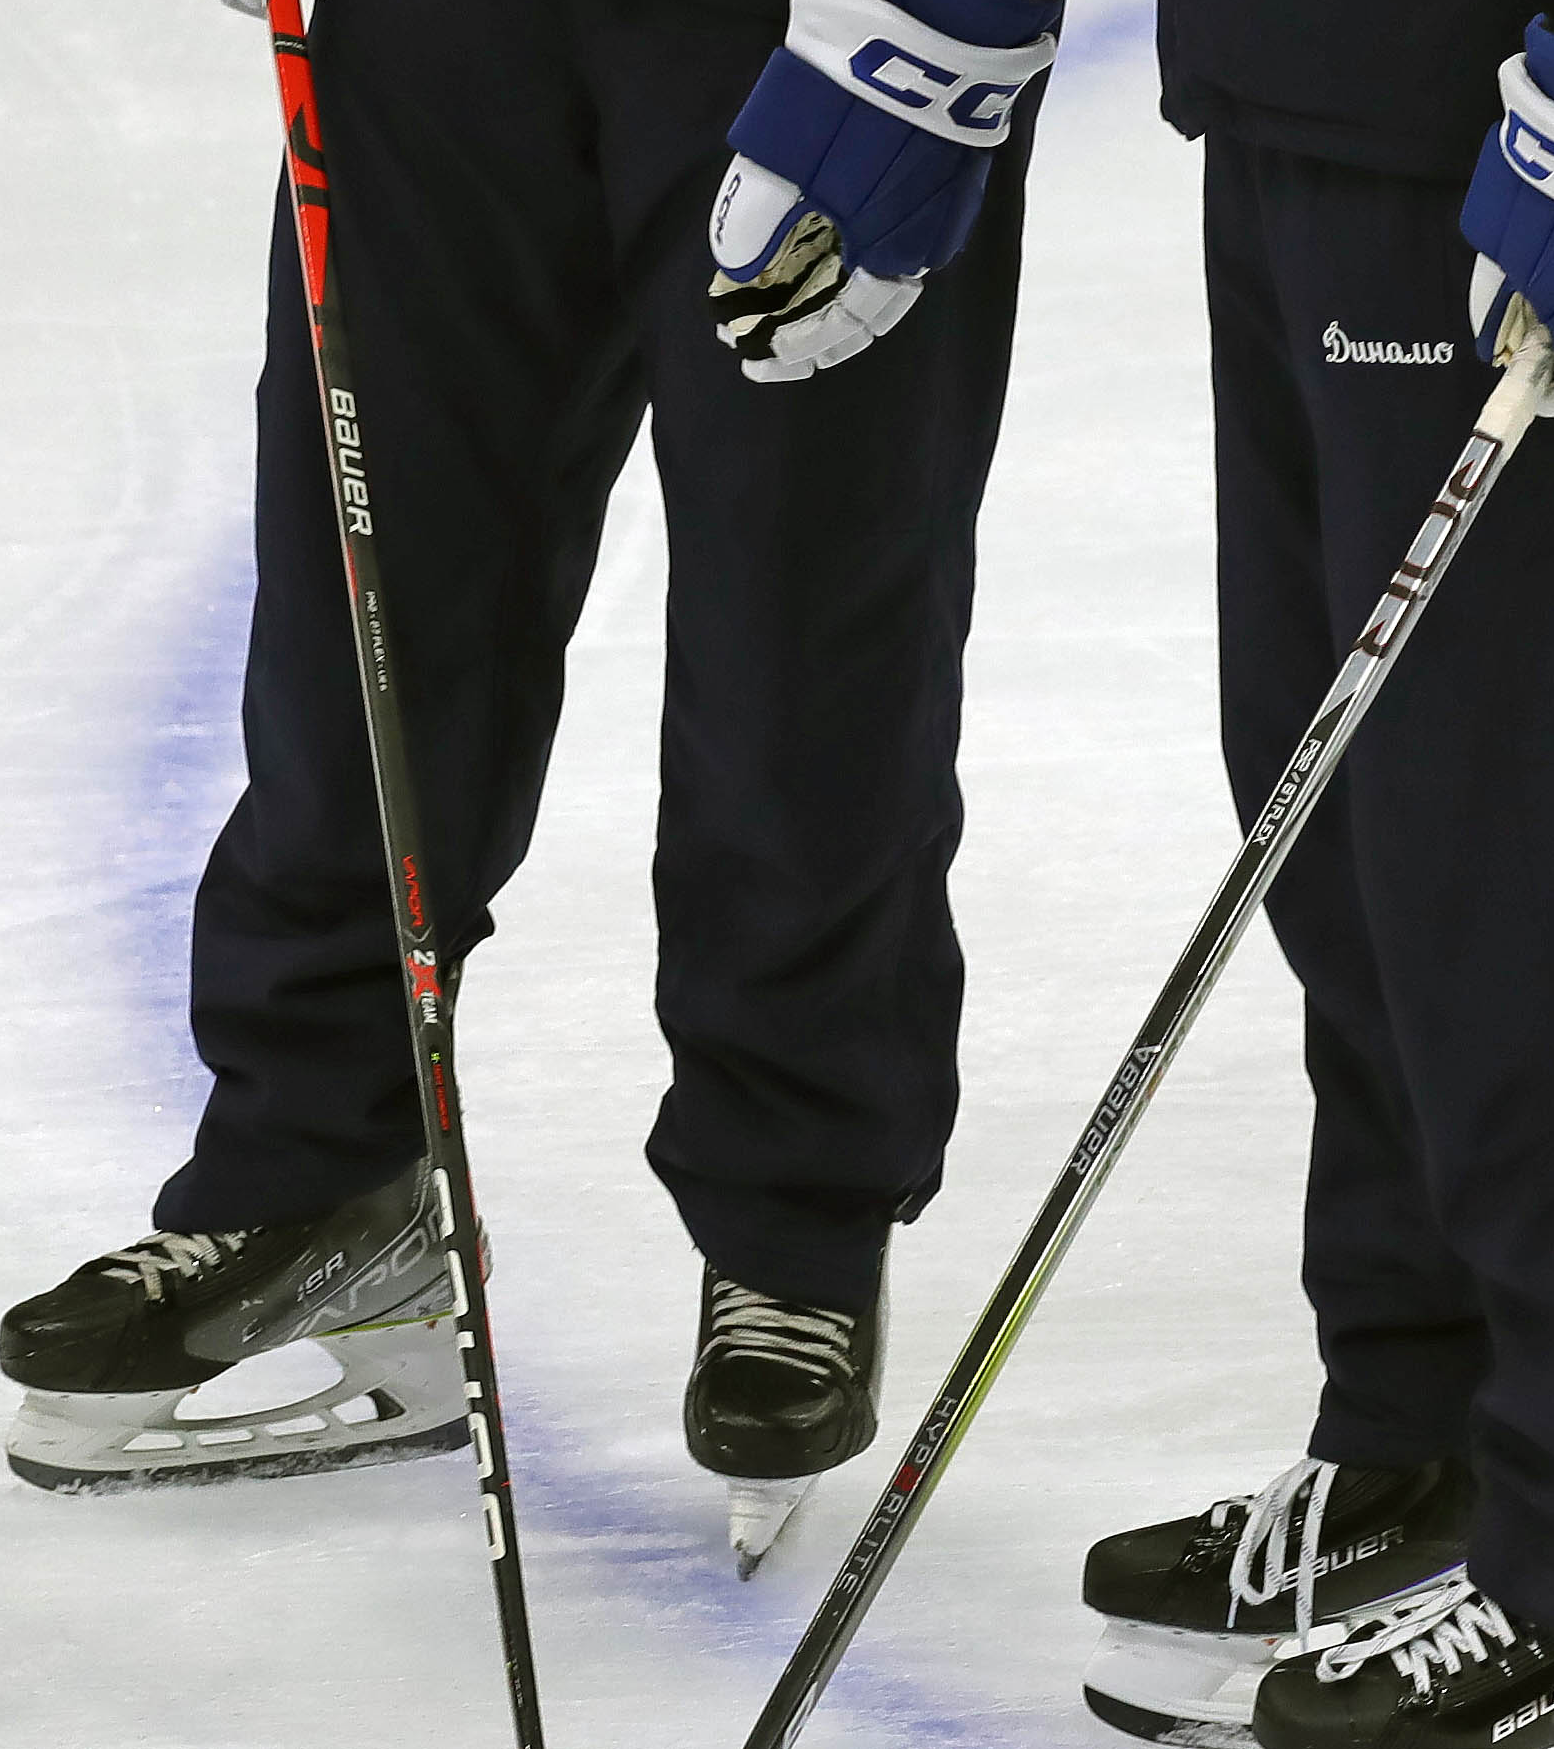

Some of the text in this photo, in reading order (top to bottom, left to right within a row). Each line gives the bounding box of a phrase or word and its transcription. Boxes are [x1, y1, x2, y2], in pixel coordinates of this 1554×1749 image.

[1322, 320, 1456, 366] Динамо
[330, 387, 374, 537] BAUER
[1252, 803, 1286, 846] FLEX
[402, 855, 424, 927] VAPOR
[1070, 1059, 1142, 1176] BAUER
